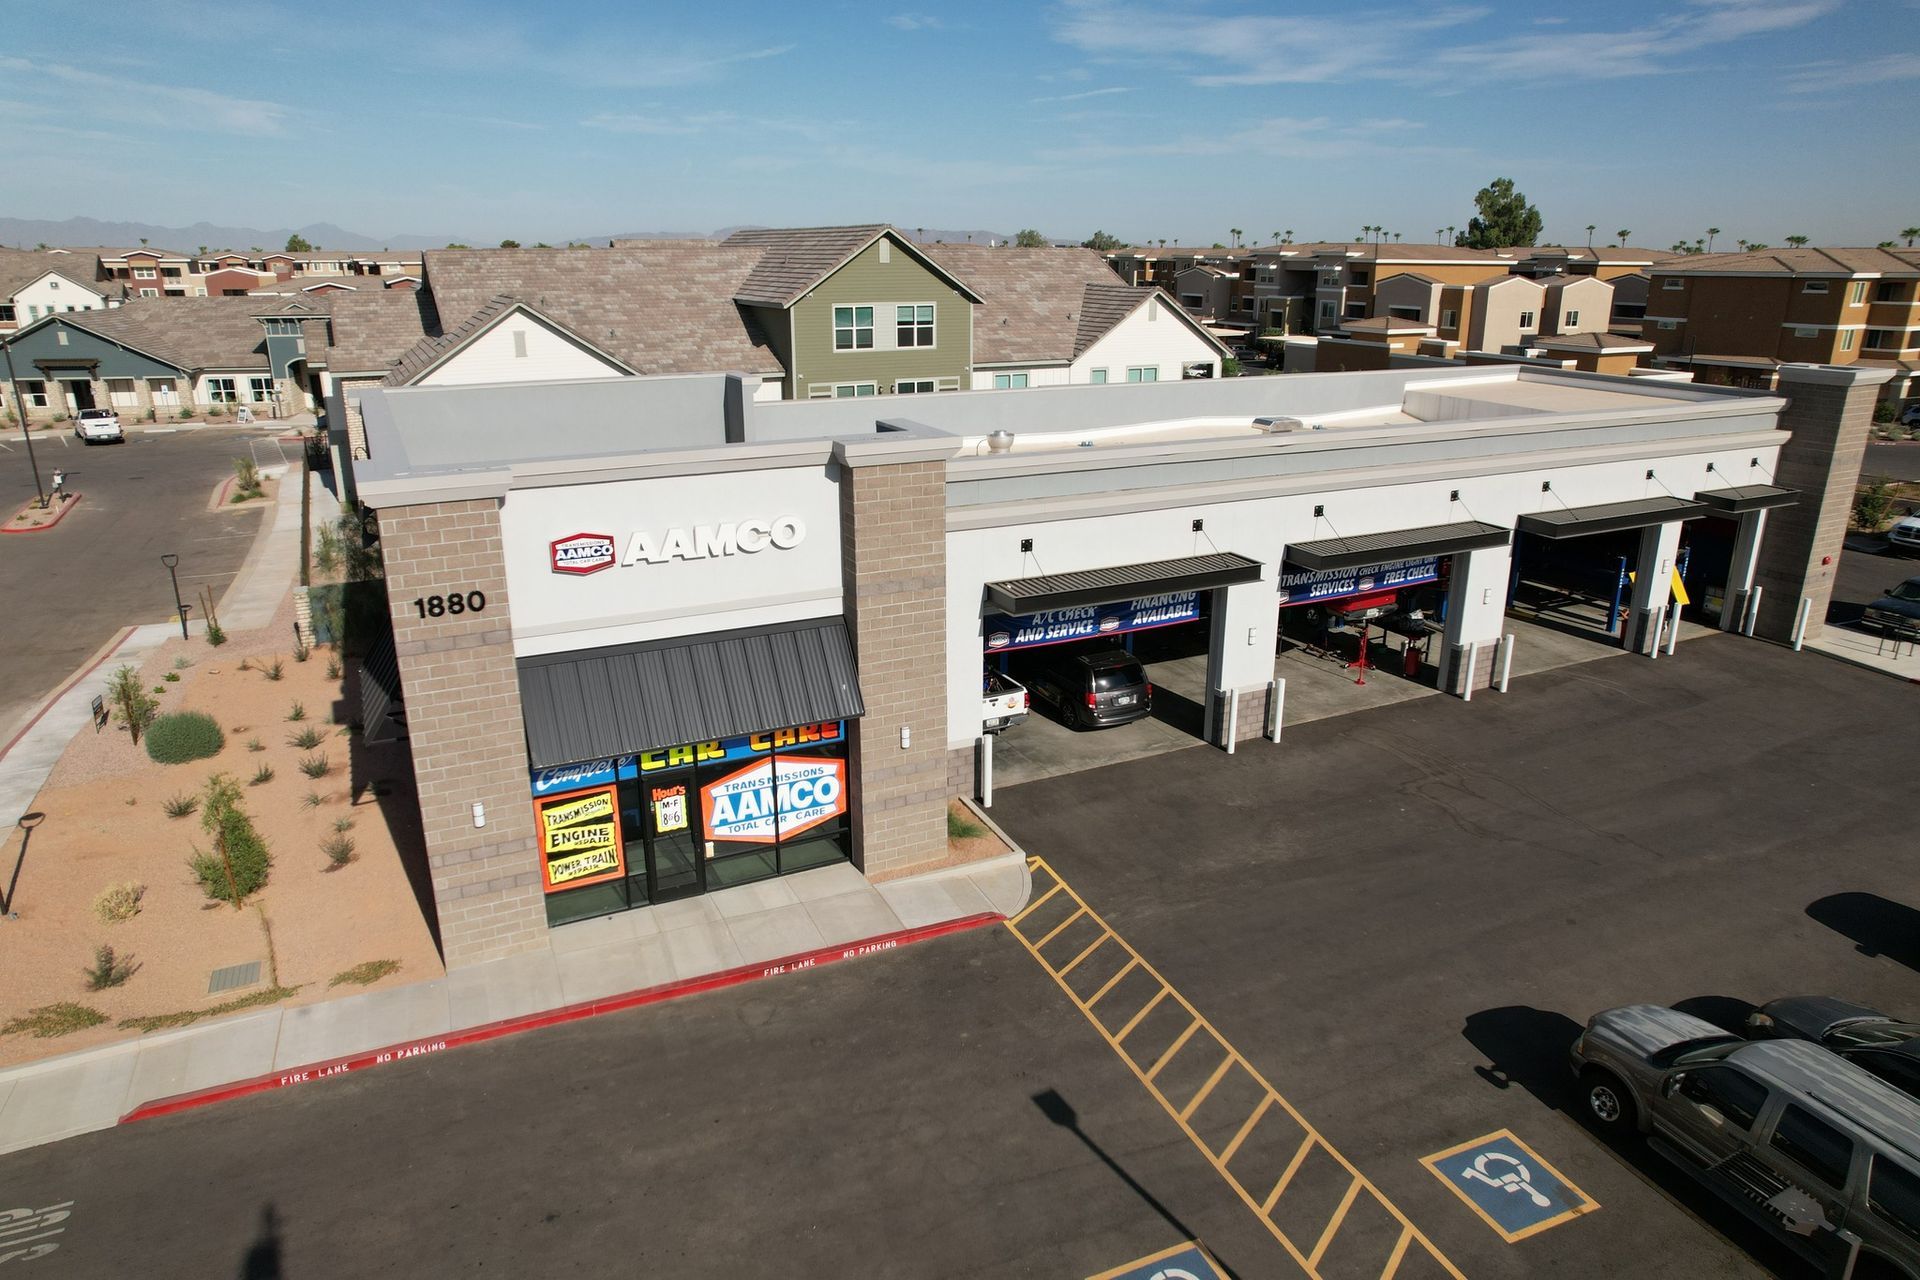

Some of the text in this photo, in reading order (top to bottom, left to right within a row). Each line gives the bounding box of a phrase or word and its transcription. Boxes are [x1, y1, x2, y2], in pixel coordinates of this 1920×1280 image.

[555, 545, 614, 561] AAMCO
[621, 515, 807, 568] AAMCO
[1282, 567, 1359, 587] TRANSMISSION
[1359, 564, 1380, 576] CHECK
[1383, 569, 1407, 585] FREE
[1406, 563, 1436, 580] CHECK
[1309, 578, 1355, 597] SERVICES
[414, 590, 486, 619] 1880
[1130, 591, 1197, 611] FINANCING
[1032, 606, 1097, 626] A/C CHECK
[1132, 602, 1194, 626] AVAILABLE
[1015, 626, 1045, 644] AND
[1045, 619, 1094, 640] SERVICE
[536, 720, 839, 792] Complete CAR CARE
[724, 766, 825, 793] TRANSMISSIONS
[546, 797, 609, 827] TRANSMISSION
[662, 799, 679, 809] M-F
[710, 775, 841, 828] AAMCO
[663, 812, 669, 826] 8
[674, 811, 681, 823] 6
[728, 806, 826, 834] TOTAL CAR CARE
[551, 827, 609, 848] ENGINE
[551, 847, 617, 880] POWER TRAIN
[764, 940, 897, 977] FIRE LANE NO PARKING
[281, 1041, 447, 1086] FIRE LANE NO PARKING
